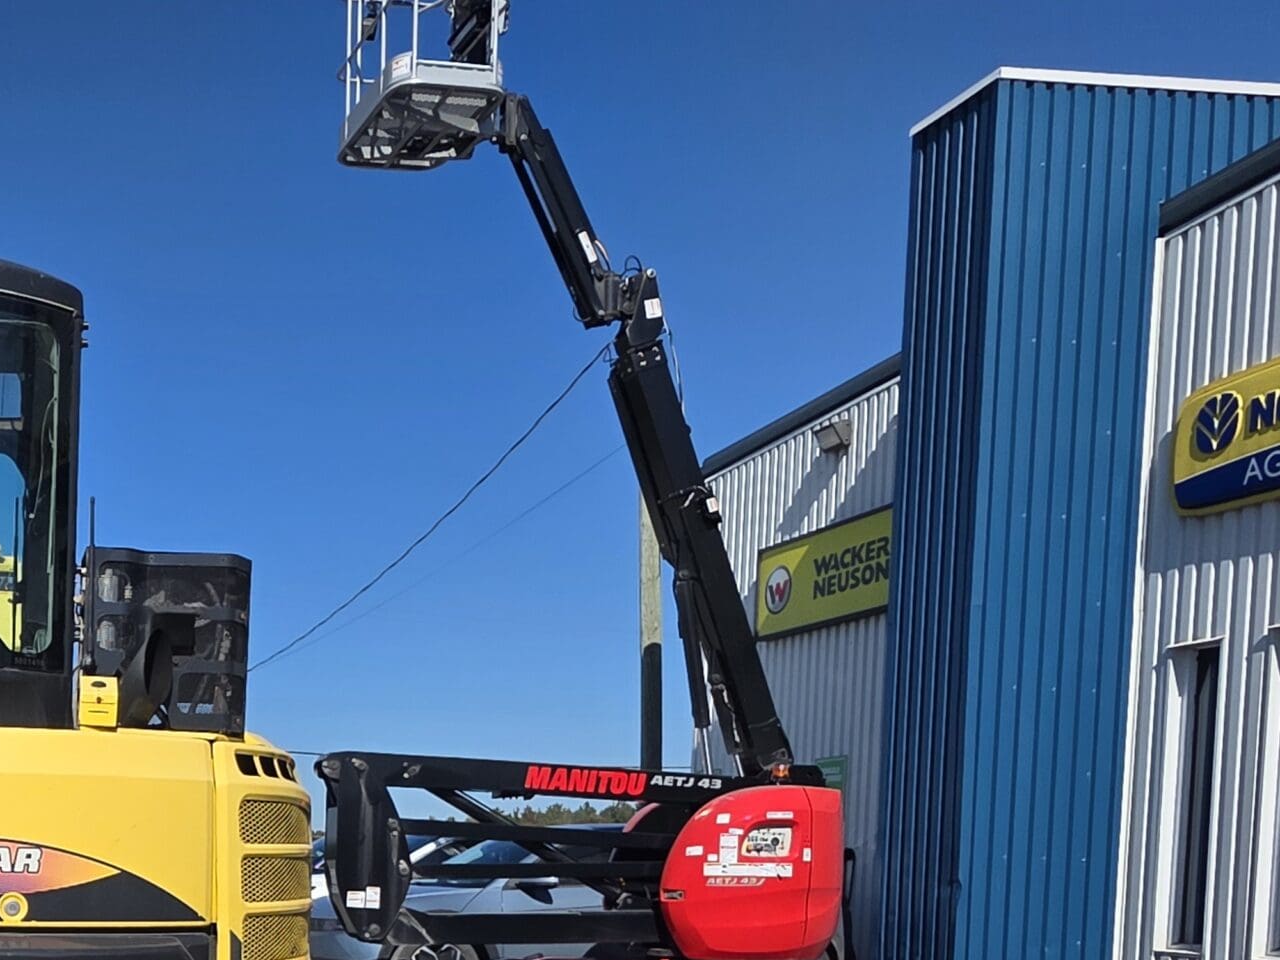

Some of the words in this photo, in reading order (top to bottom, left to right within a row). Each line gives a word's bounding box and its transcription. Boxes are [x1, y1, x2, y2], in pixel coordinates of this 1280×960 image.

[813, 536, 890, 577] WACKER
[812, 558, 890, 600] NEUSON
[524, 765, 647, 796] MANITOU
[650, 774, 695, 788] AETJ
[697, 777, 722, 790] 43
